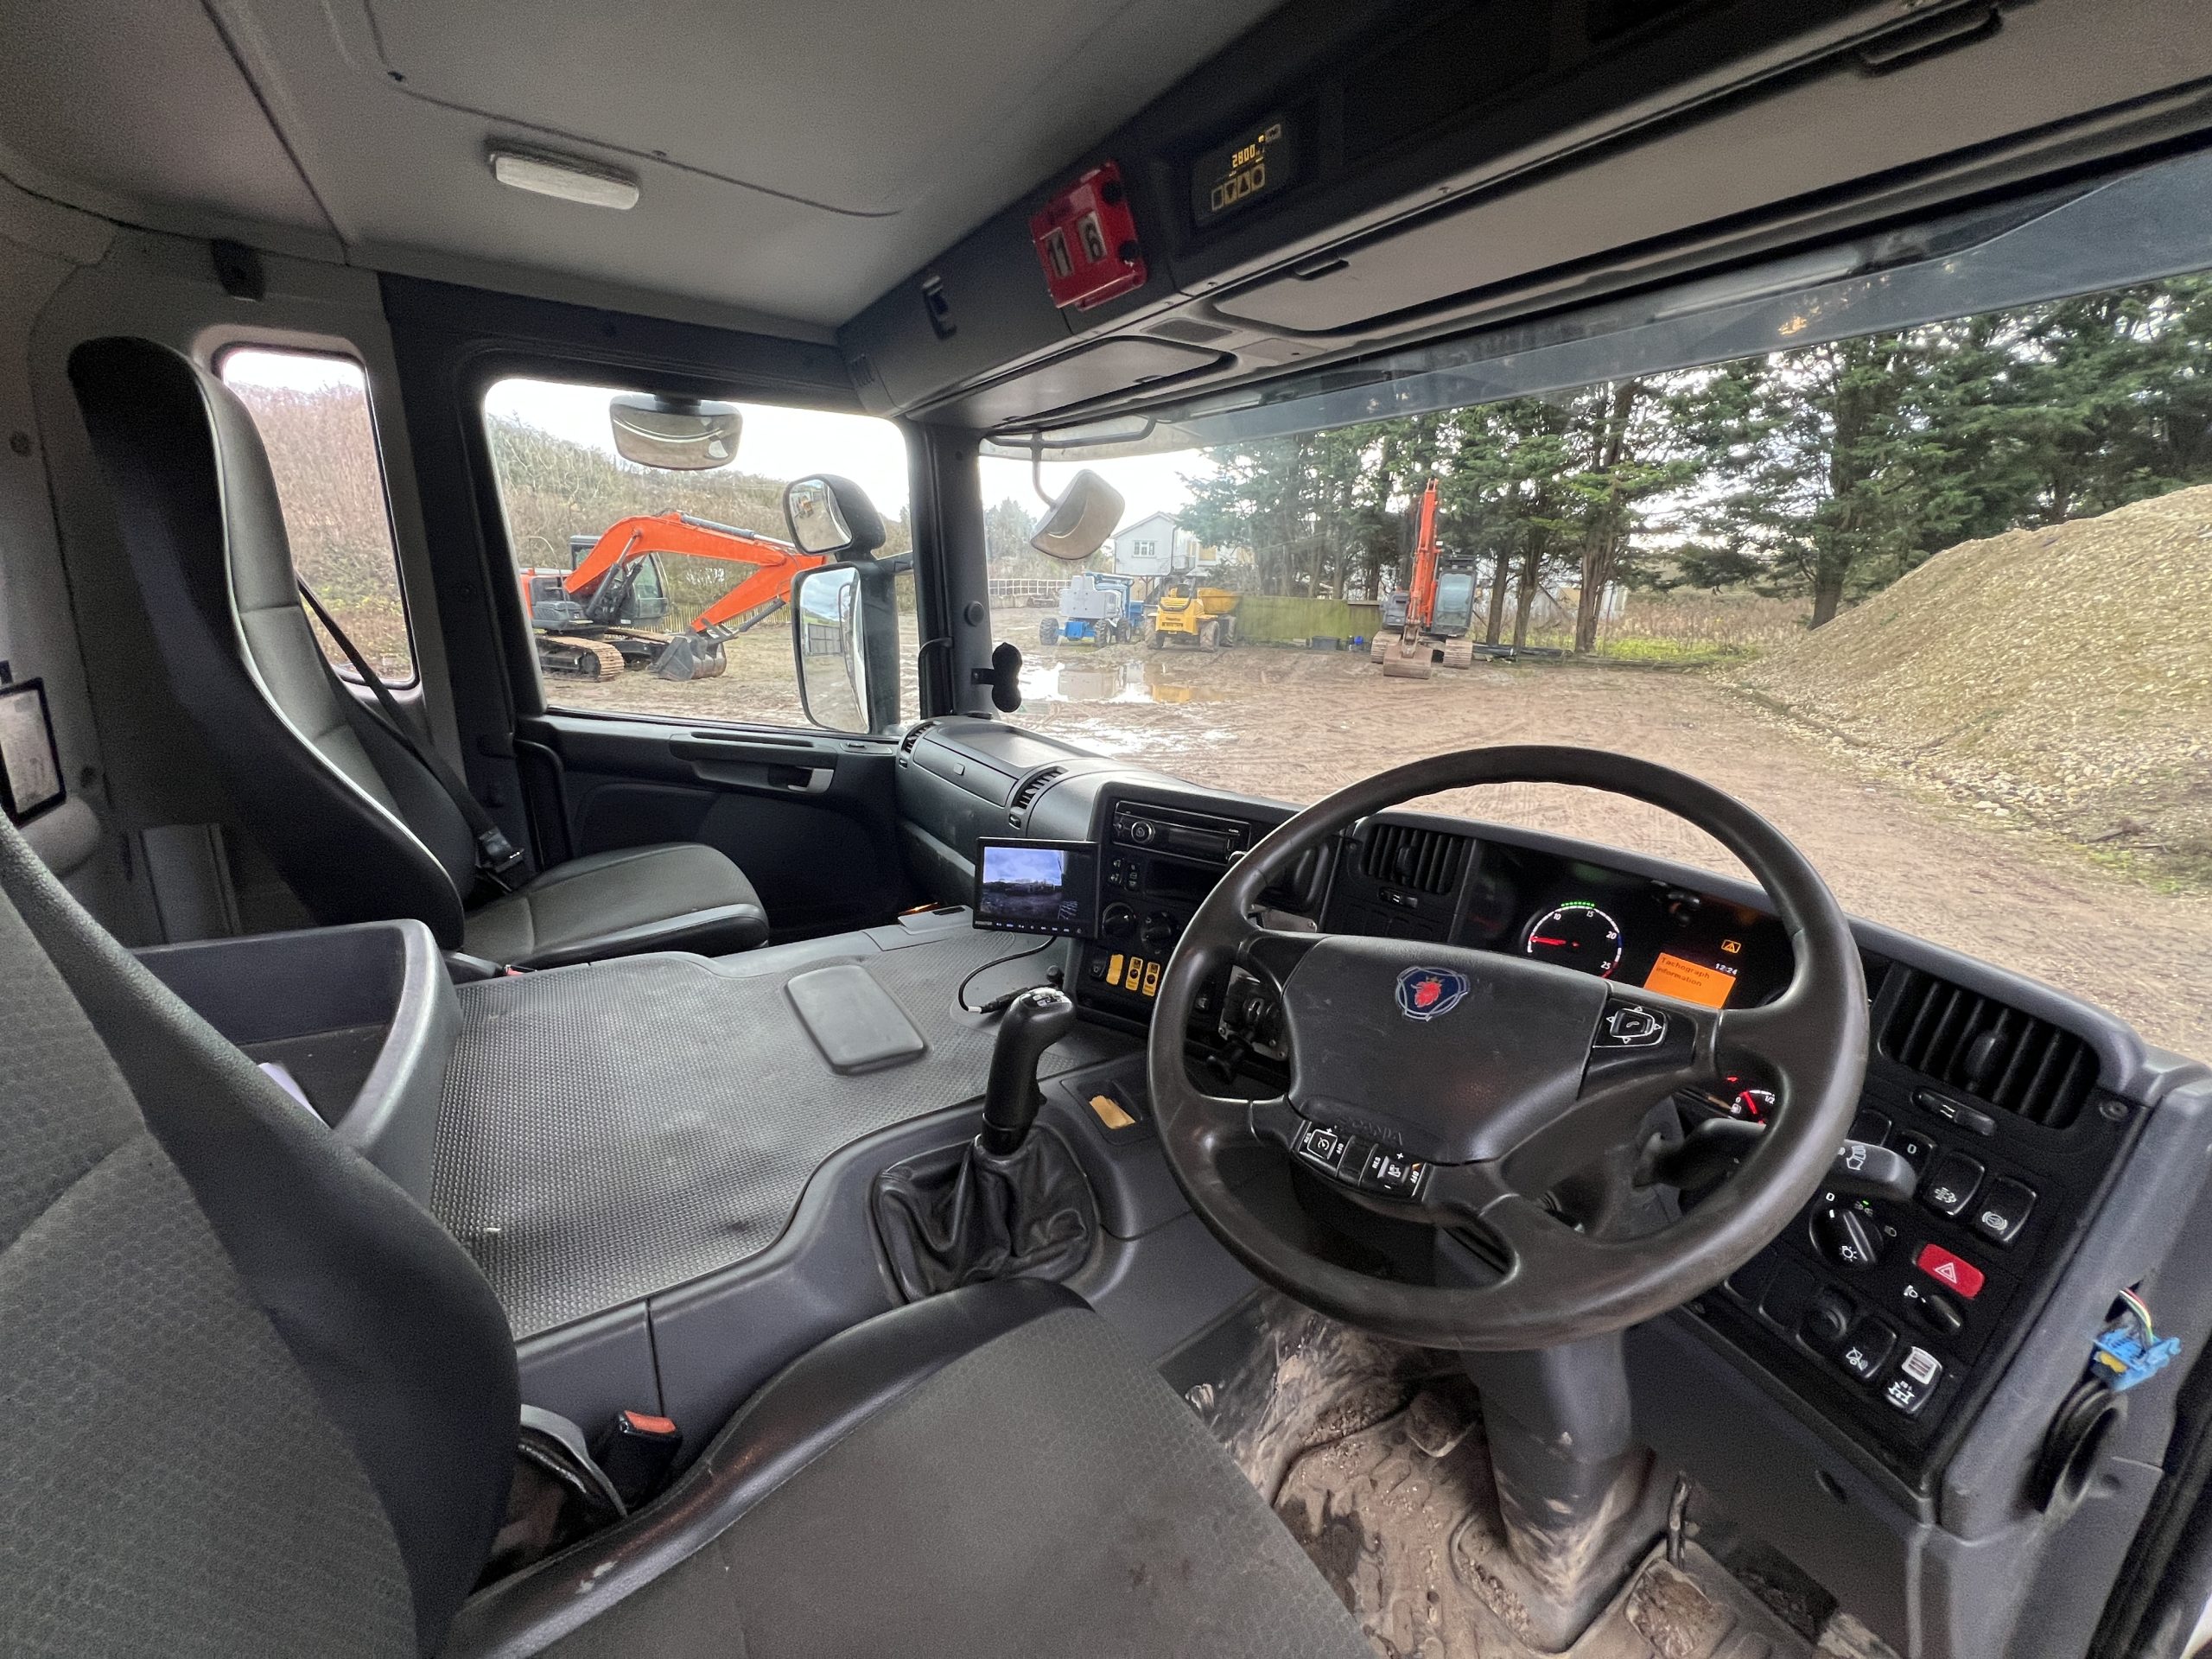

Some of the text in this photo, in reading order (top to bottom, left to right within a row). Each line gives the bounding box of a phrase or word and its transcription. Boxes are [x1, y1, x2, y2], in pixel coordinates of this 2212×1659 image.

[1231, 143, 1255, 168] 2800
[1553, 912, 1562, 921] 10
[1605, 931, 1618, 940] 20
[1600, 961, 1611, 970] 25
[1661, 957, 1711, 980] Tachograph
[1656, 968, 1702, 987] information
